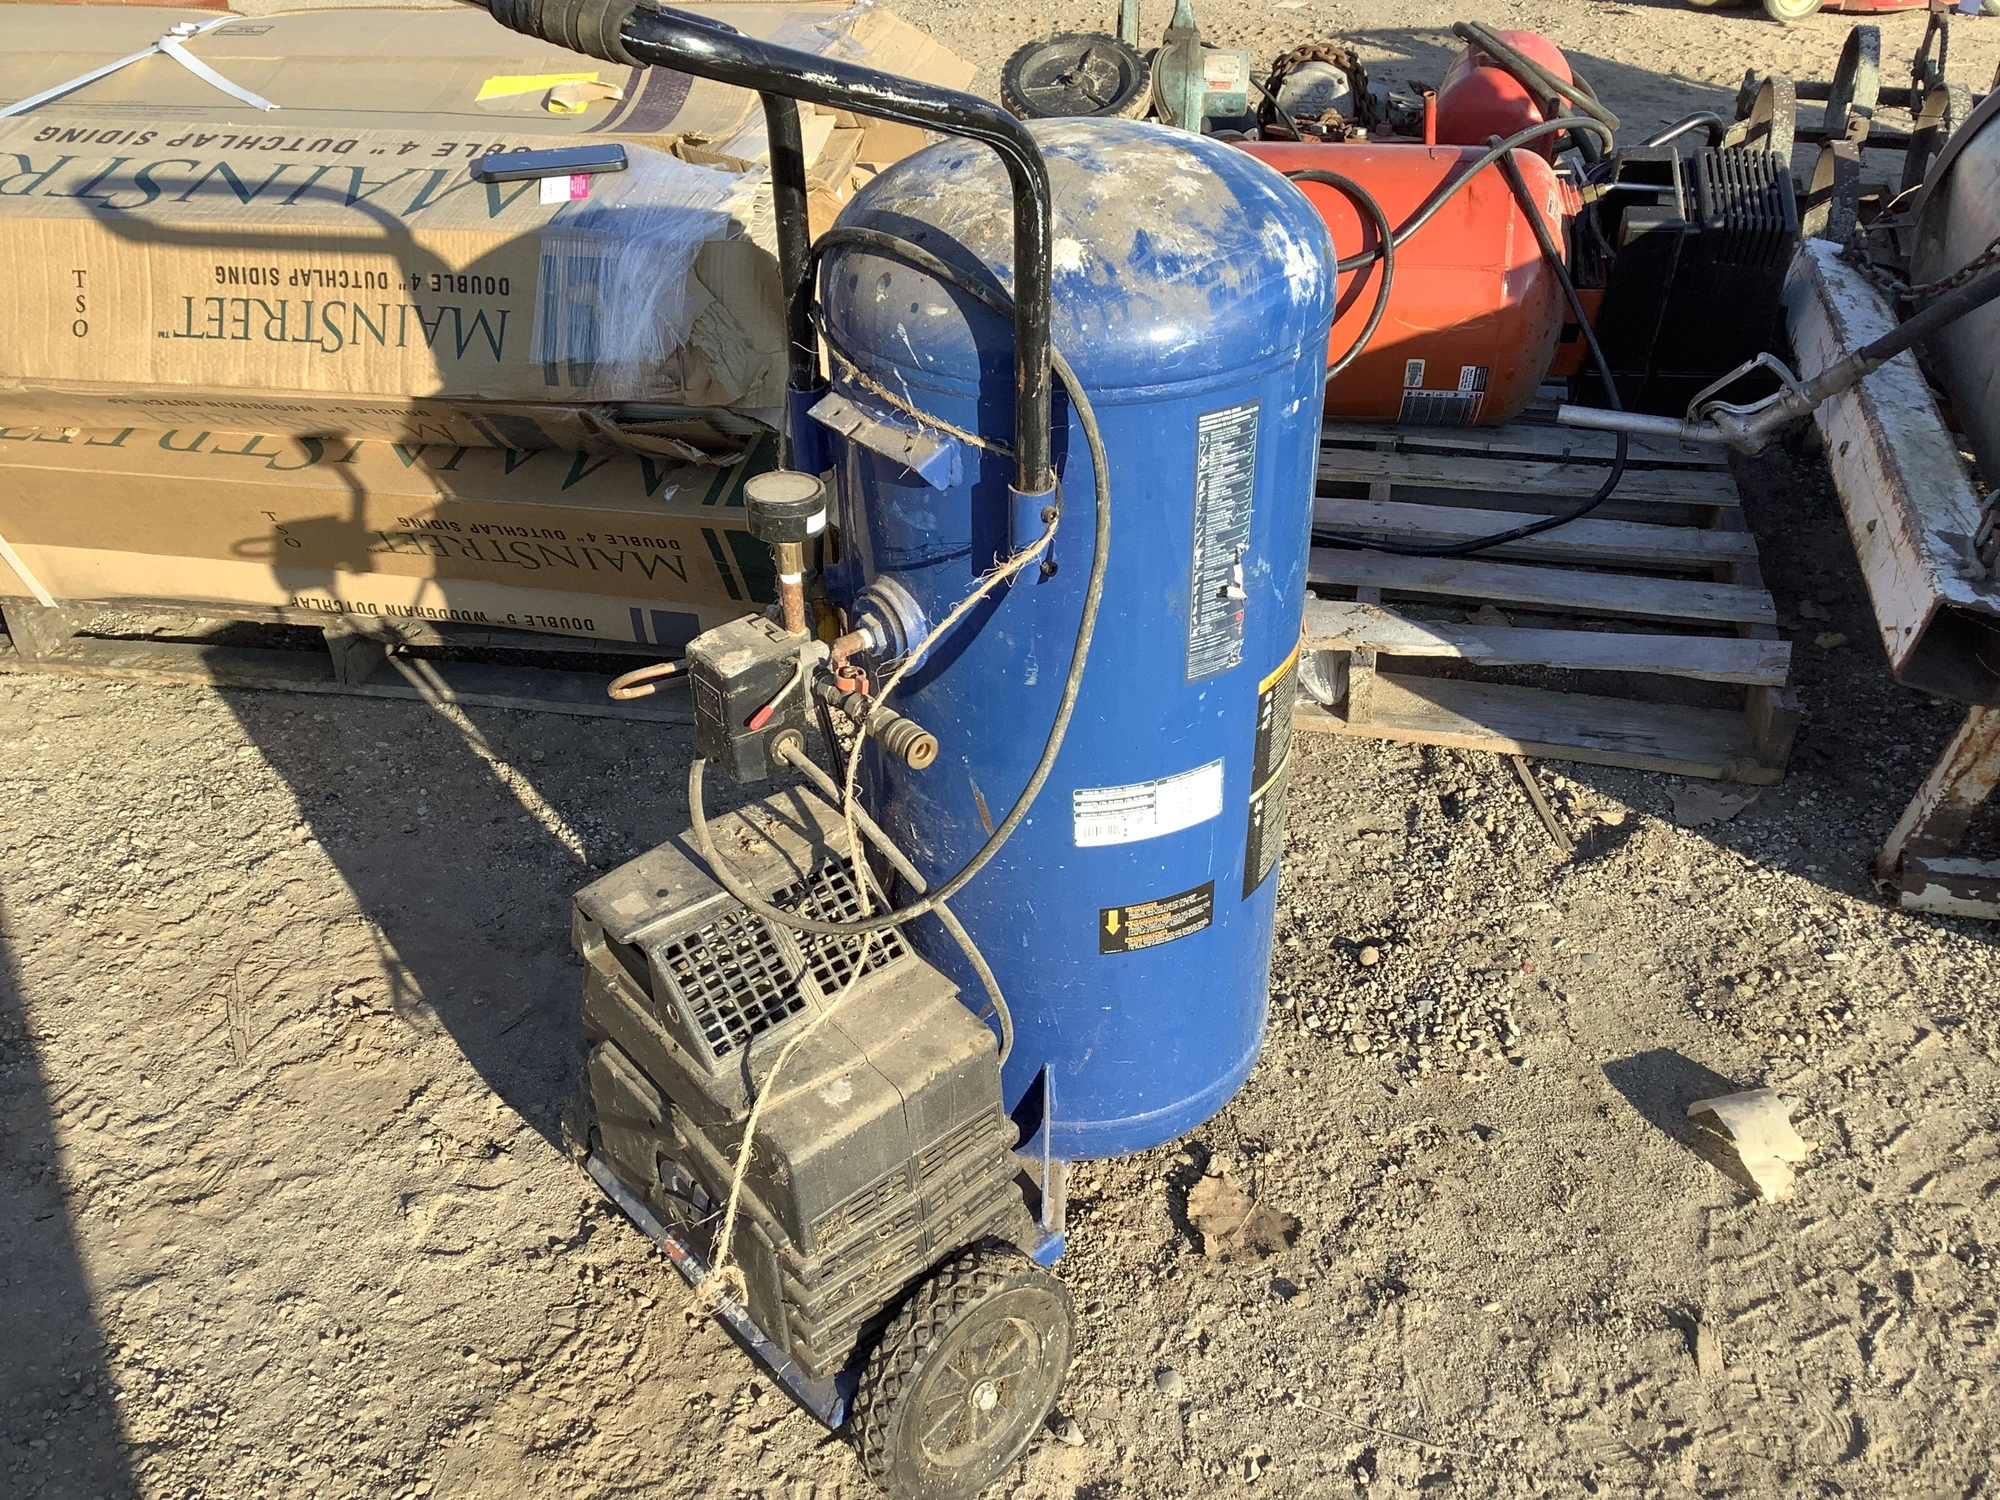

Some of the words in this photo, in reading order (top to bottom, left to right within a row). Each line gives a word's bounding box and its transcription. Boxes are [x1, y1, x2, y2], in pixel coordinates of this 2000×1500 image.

[33, 126, 158, 147] SIDING
[164, 133, 358, 154] DUTCHLAP
[215, 265, 279, 286] SIDING
[288, 268, 388, 290] DUTCHLAP
[398, 272, 422, 291] 4"
[430, 273, 509, 296] DOUBLE
[396, 517, 460, 533] SIDING
[469, 522, 566, 541] DUTCHLAP
[575, 531, 597, 544] 4"
[604, 533, 681, 551] DOUBLE
[289, 596, 379, 616] DUTCHLAP
[384, 603, 487, 623] WOODGRAIN
[497, 613, 517, 625] 5"
[524, 613, 595, 632] DOUBLE
